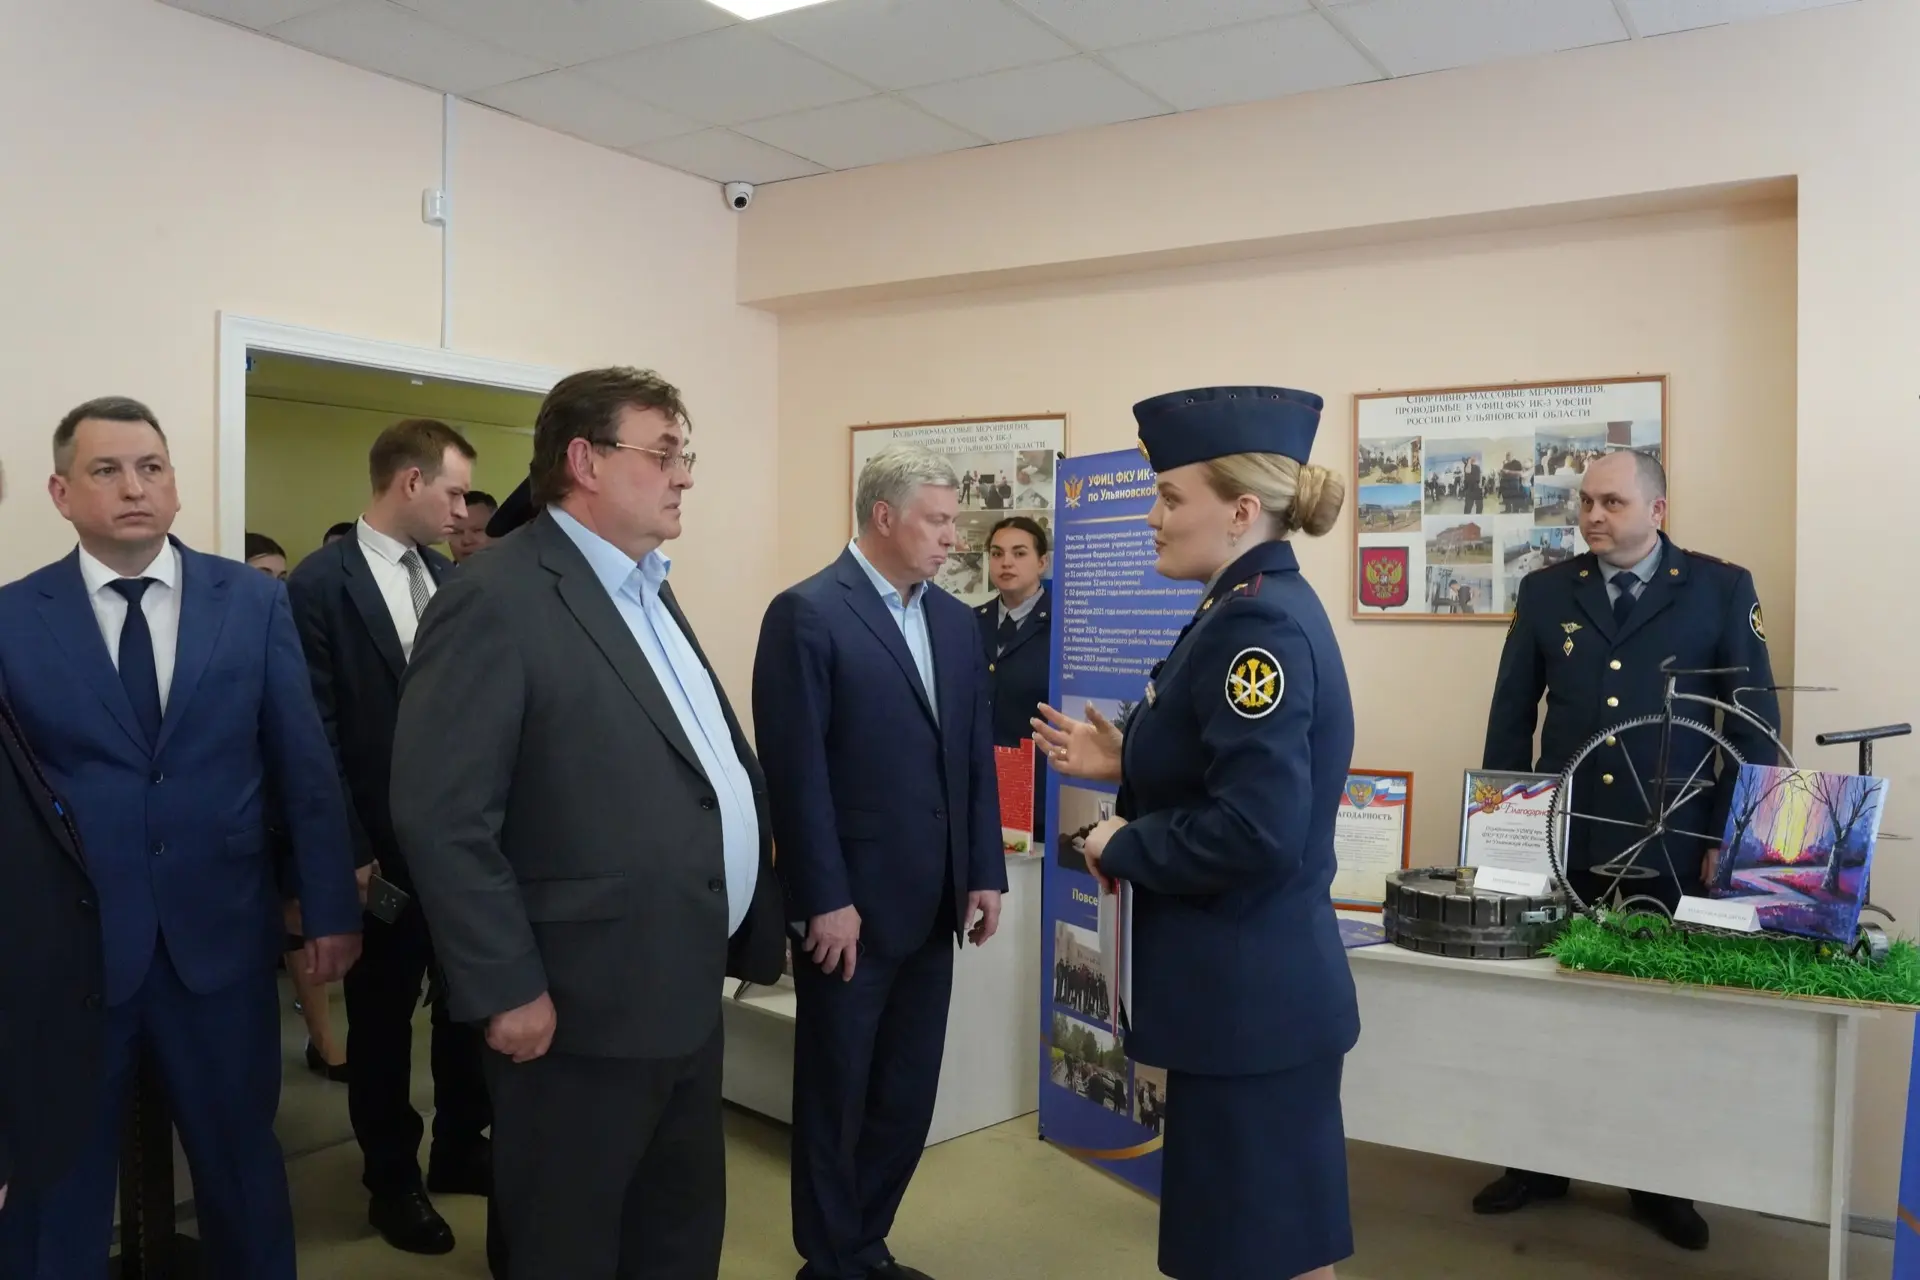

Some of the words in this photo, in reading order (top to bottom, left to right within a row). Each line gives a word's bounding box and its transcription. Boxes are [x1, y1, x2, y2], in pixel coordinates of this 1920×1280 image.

[1543, 409, 1591, 419] ОБЛАСТИ
[1088, 473, 1114, 487] УФИЦ
[1116, 470, 1135, 484] ФКУ
[1088, 492, 1099, 502] по
[1100, 484, 1157, 501] Ульяновской
